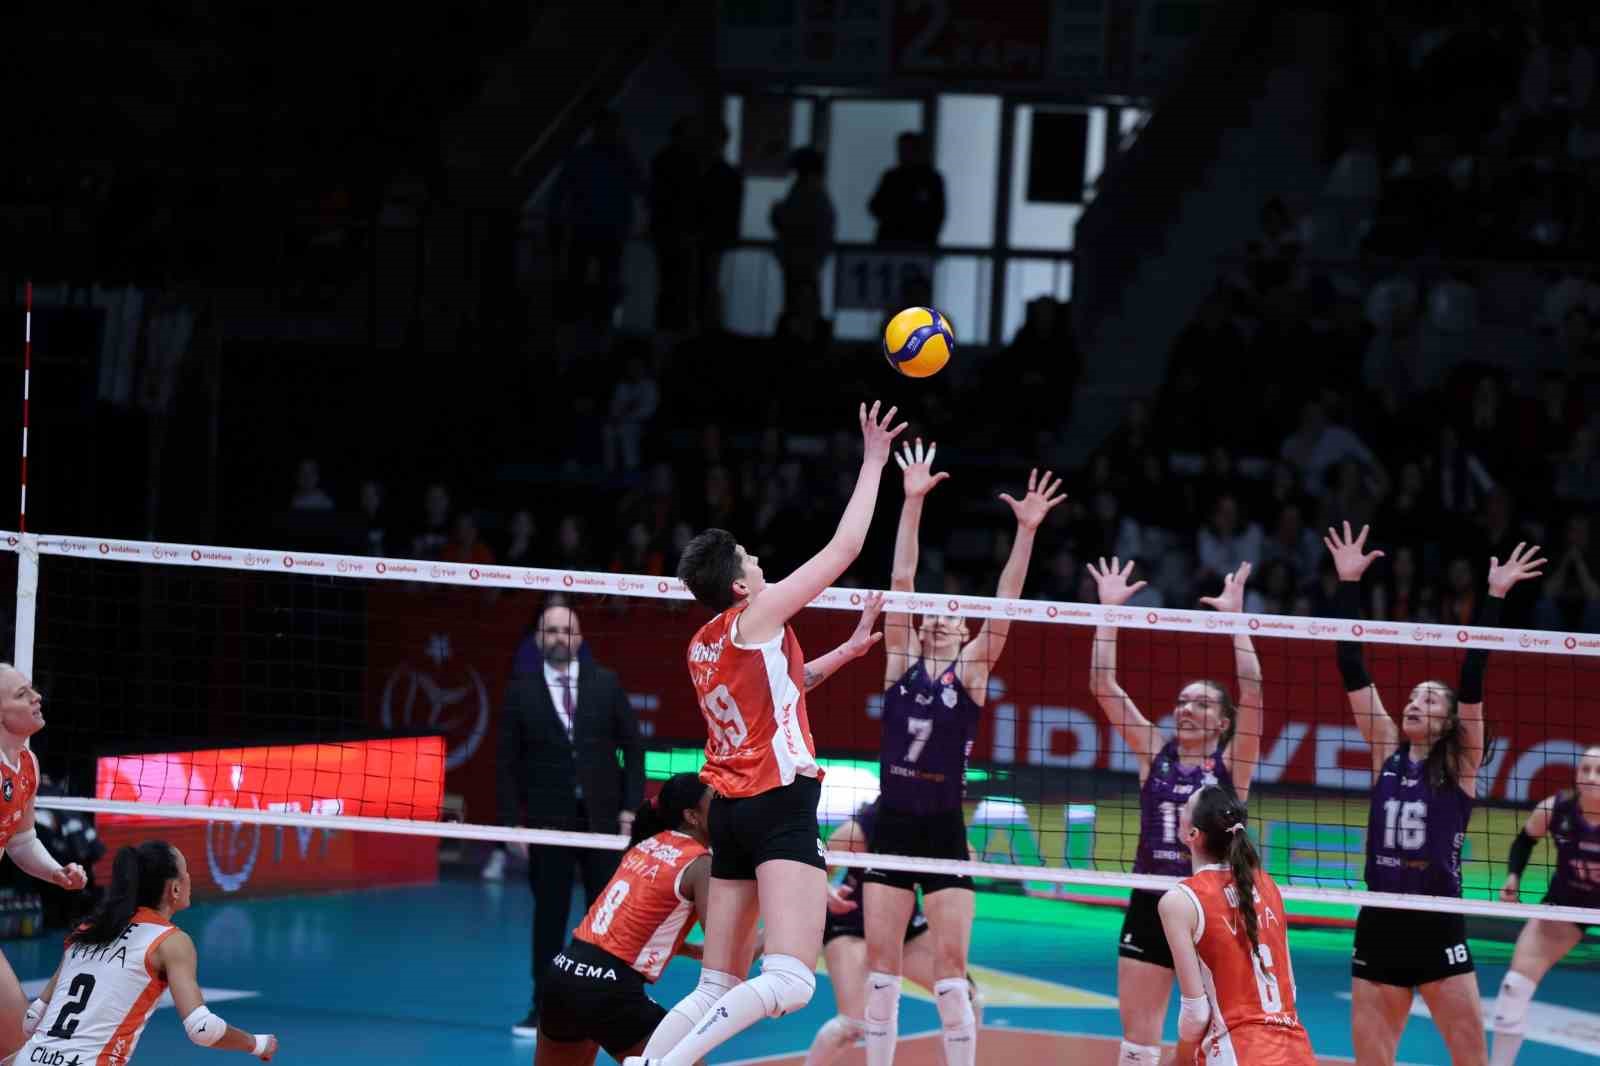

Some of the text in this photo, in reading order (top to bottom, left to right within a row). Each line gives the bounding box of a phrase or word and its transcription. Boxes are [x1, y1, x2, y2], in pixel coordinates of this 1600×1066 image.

[906, 716, 934, 763] 7
[1383, 800, 1427, 850] 16
[591, 879, 630, 936] 8
[1251, 943, 1282, 1014] 6
[1445, 943, 1469, 965] 16
[47, 972, 96, 1040] 2
